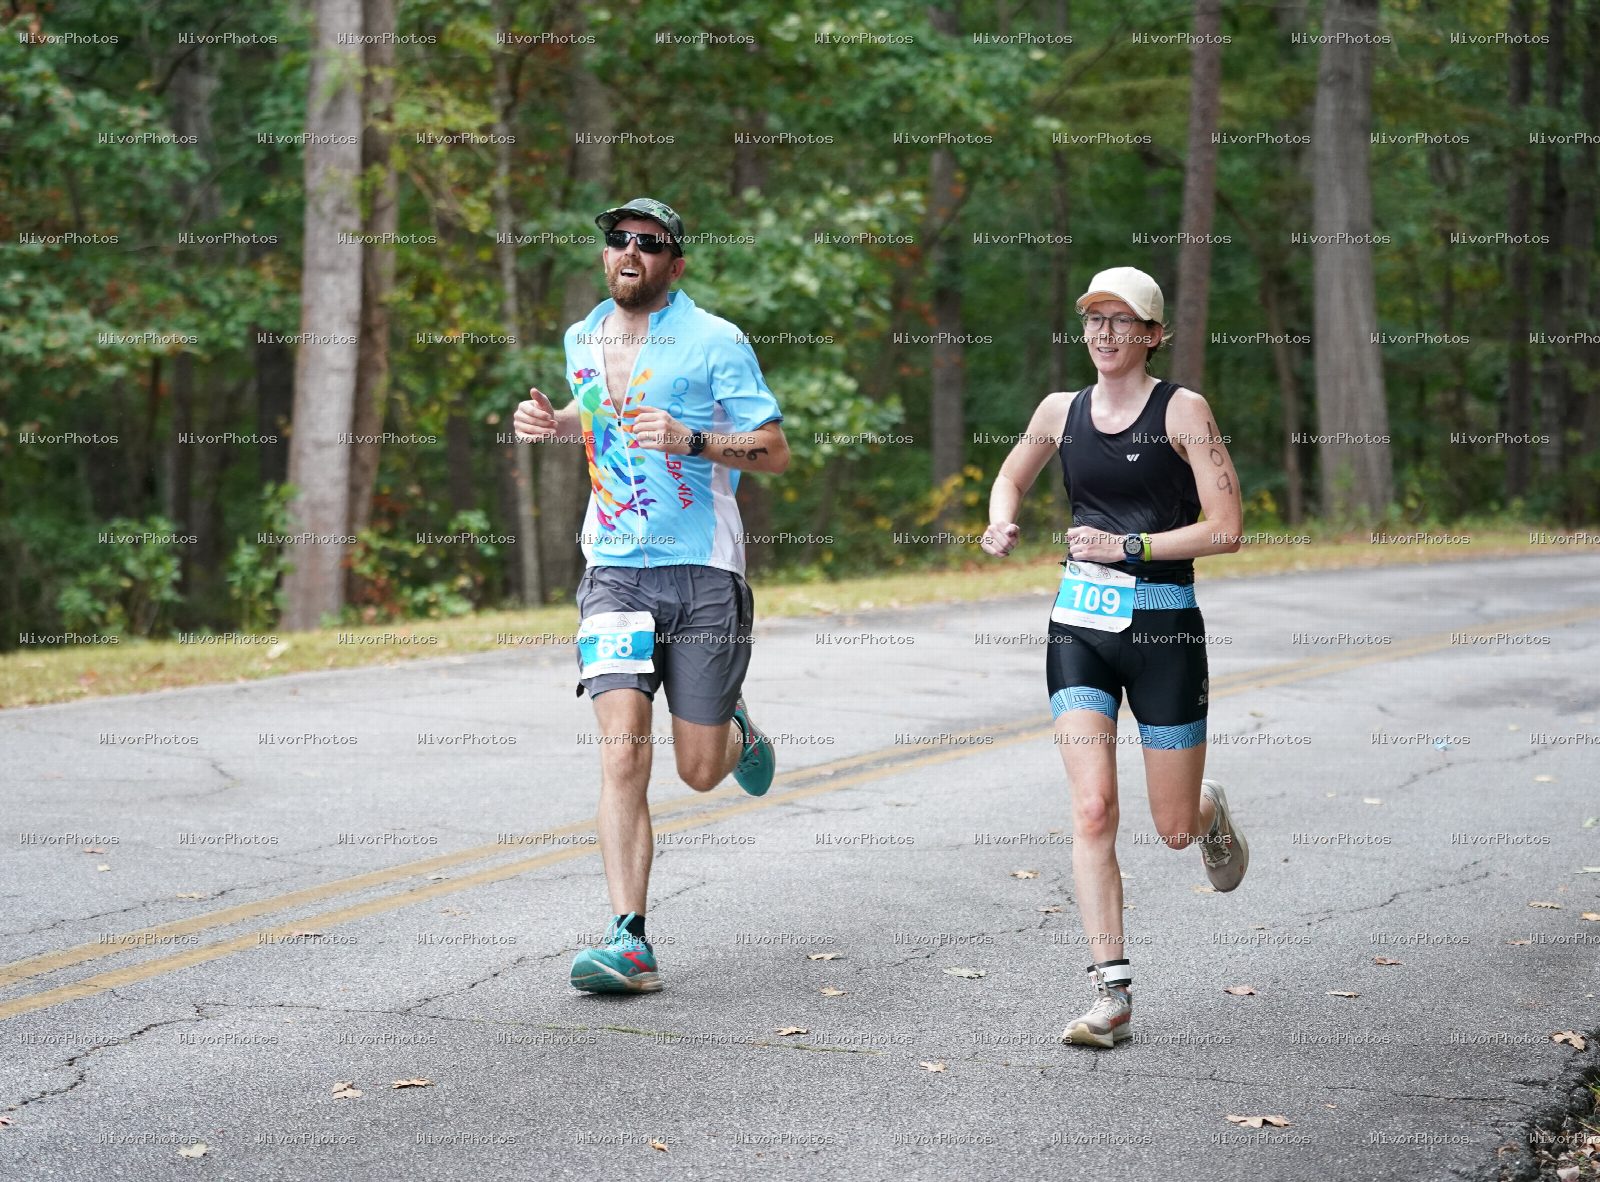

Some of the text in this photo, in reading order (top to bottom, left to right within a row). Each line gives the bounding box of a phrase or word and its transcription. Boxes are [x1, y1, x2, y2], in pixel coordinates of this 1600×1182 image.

[1206, 420, 1234, 496] 109
[1072, 583, 1121, 615] 109
[597, 633, 633, 658] 68
